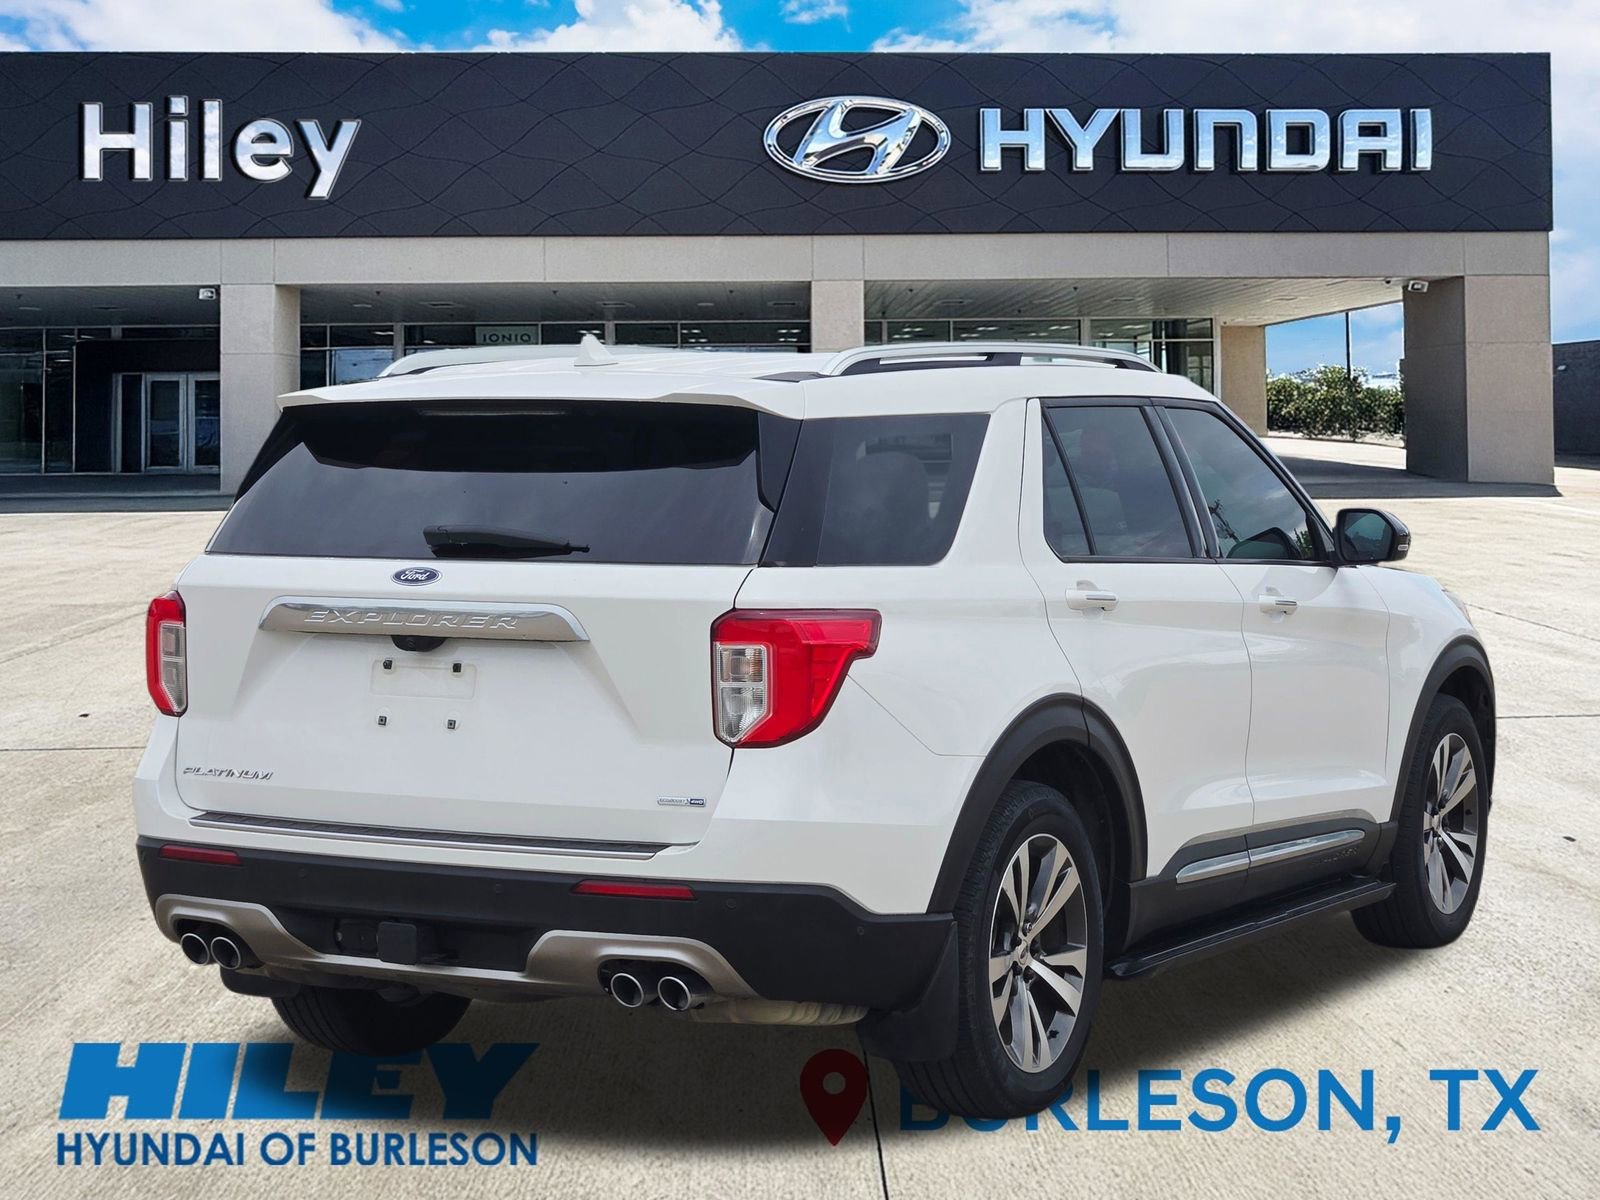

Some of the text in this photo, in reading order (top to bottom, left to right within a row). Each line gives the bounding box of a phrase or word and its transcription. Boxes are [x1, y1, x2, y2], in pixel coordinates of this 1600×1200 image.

[82, 95, 362, 199] Hiley
[980, 107, 1433, 172] HYUNDAI
[482, 332, 532, 343] IONIQ
[400, 569, 431, 581] Ford
[303, 609, 519, 630] EXPLORER
[182, 766, 274, 781] PLATINUM
